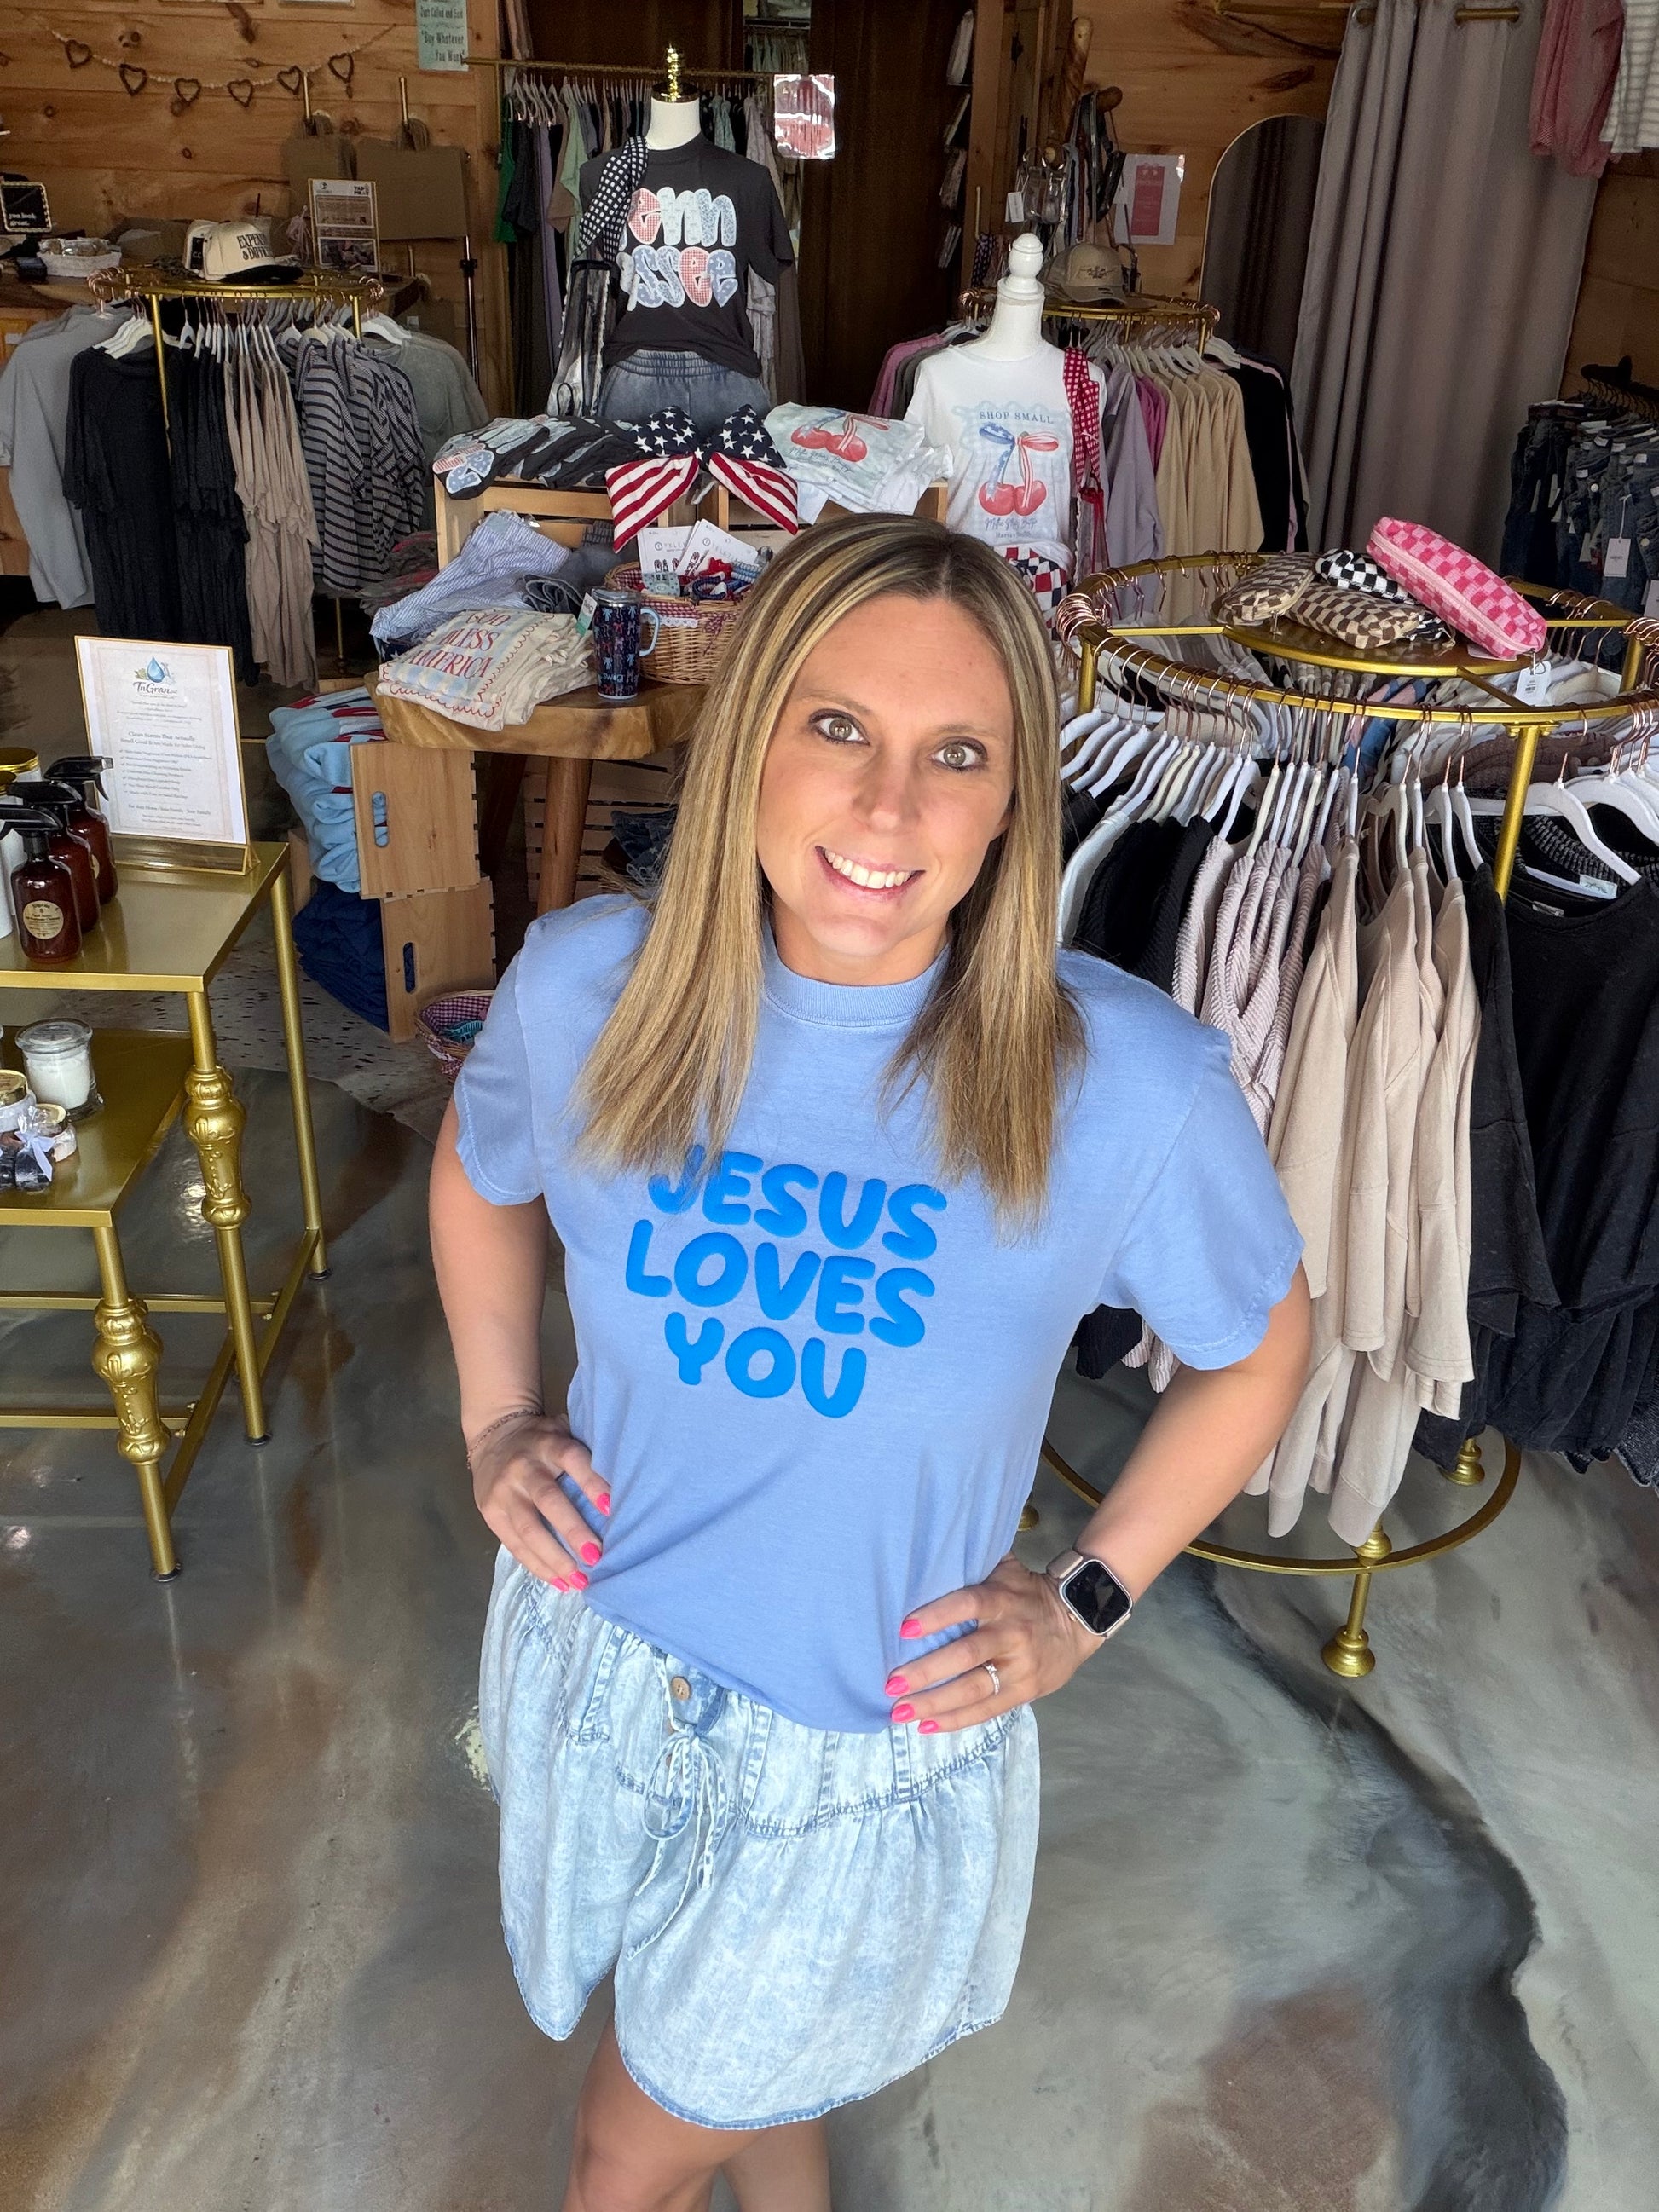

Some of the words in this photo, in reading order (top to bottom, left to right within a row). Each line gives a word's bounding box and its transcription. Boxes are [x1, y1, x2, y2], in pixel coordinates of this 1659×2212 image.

[980, 411, 1009, 419] SHOP
[1014, 412, 1054, 424] SMALL
[648, 1144, 947, 1261] JESUS
[626, 1219, 935, 1348] LOVES
[664, 1311, 867, 1418] YOU
